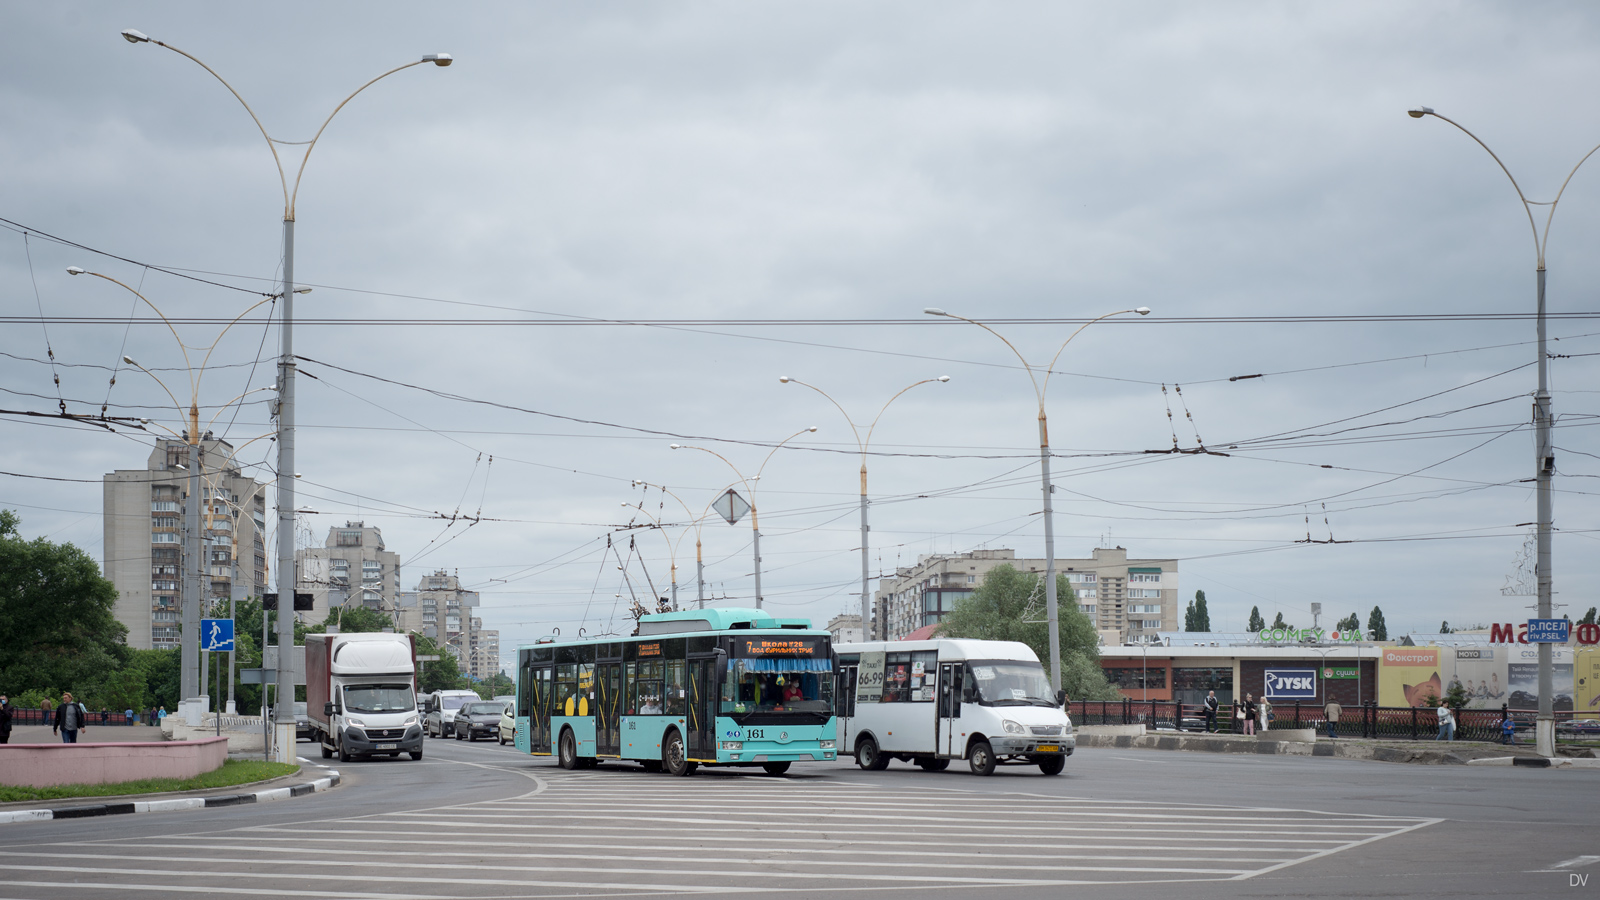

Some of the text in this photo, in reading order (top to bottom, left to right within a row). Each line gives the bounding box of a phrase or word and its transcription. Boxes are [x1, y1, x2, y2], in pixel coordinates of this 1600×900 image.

[1530, 622, 1566, 633] р.ПСЕЛ
[1260, 628, 1363, 641] COMFY UA
[746, 641, 753, 653] 7
[1386, 653, 1434, 663] Фокстрот
[1275, 677, 1313, 690] JYSK
[747, 729, 765, 738] 161
